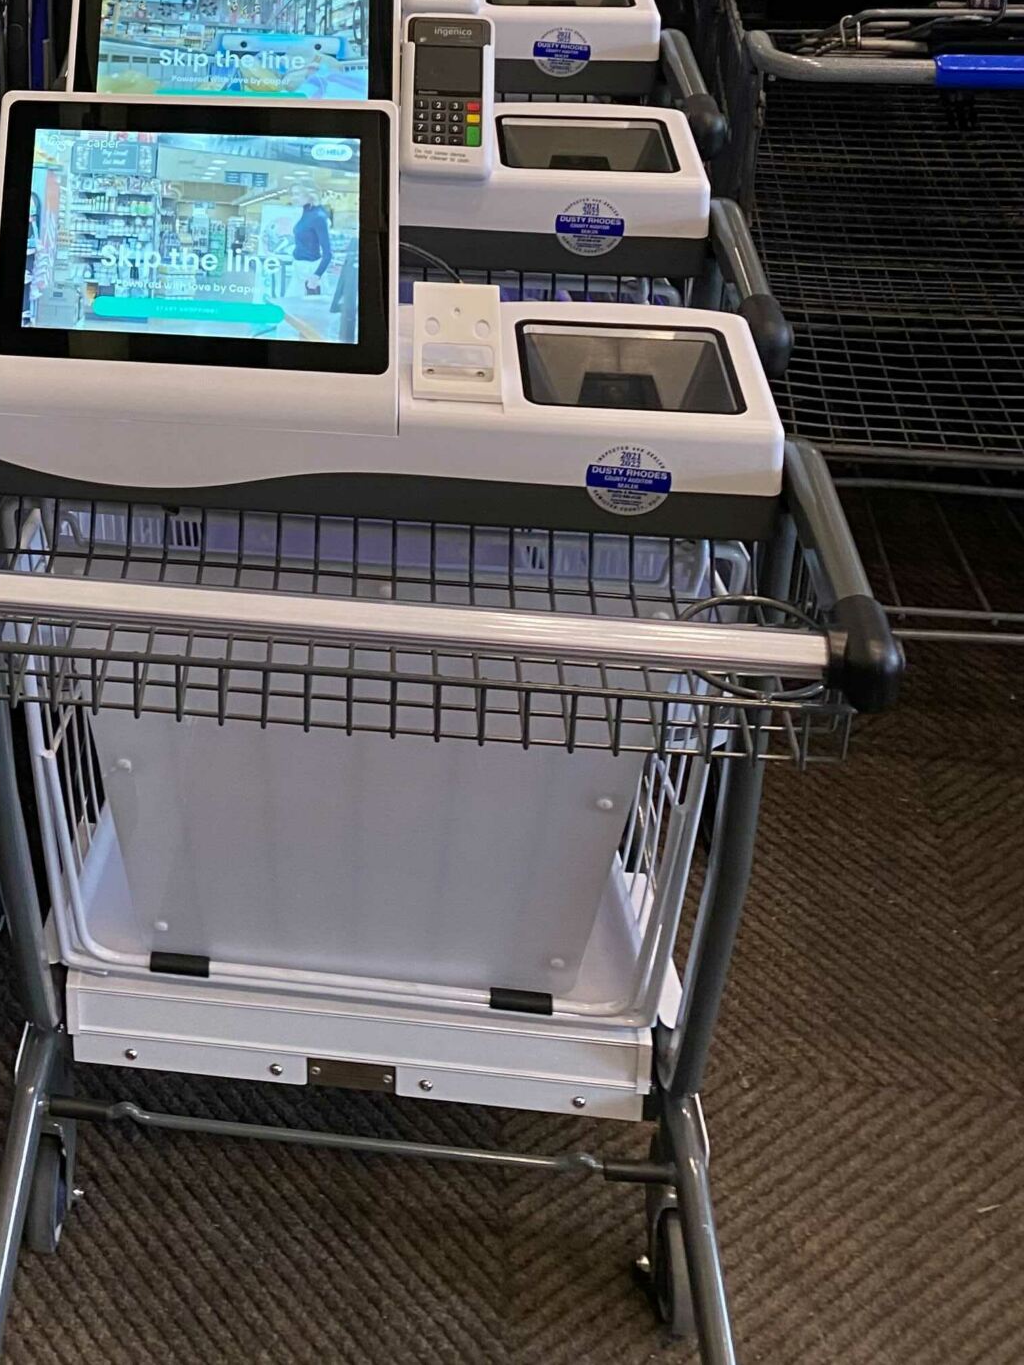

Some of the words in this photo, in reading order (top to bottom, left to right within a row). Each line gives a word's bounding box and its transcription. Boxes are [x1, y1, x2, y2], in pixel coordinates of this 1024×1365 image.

[434, 26, 473, 36] ingenico
[159, 48, 209, 73] Skip
[215, 49, 255, 68] the
[262, 49, 306, 69] line
[87, 139, 120, 149] caper
[560, 215, 587, 223] DUSTY
[101, 244, 162, 269] Skip
[169, 247, 219, 271] the
[227, 248, 281, 273] line
[213, 284, 228, 294] by
[620, 451, 642, 460] 2021
[591, 465, 625, 475] DUSTY
[626, 468, 669, 480] RHODES
